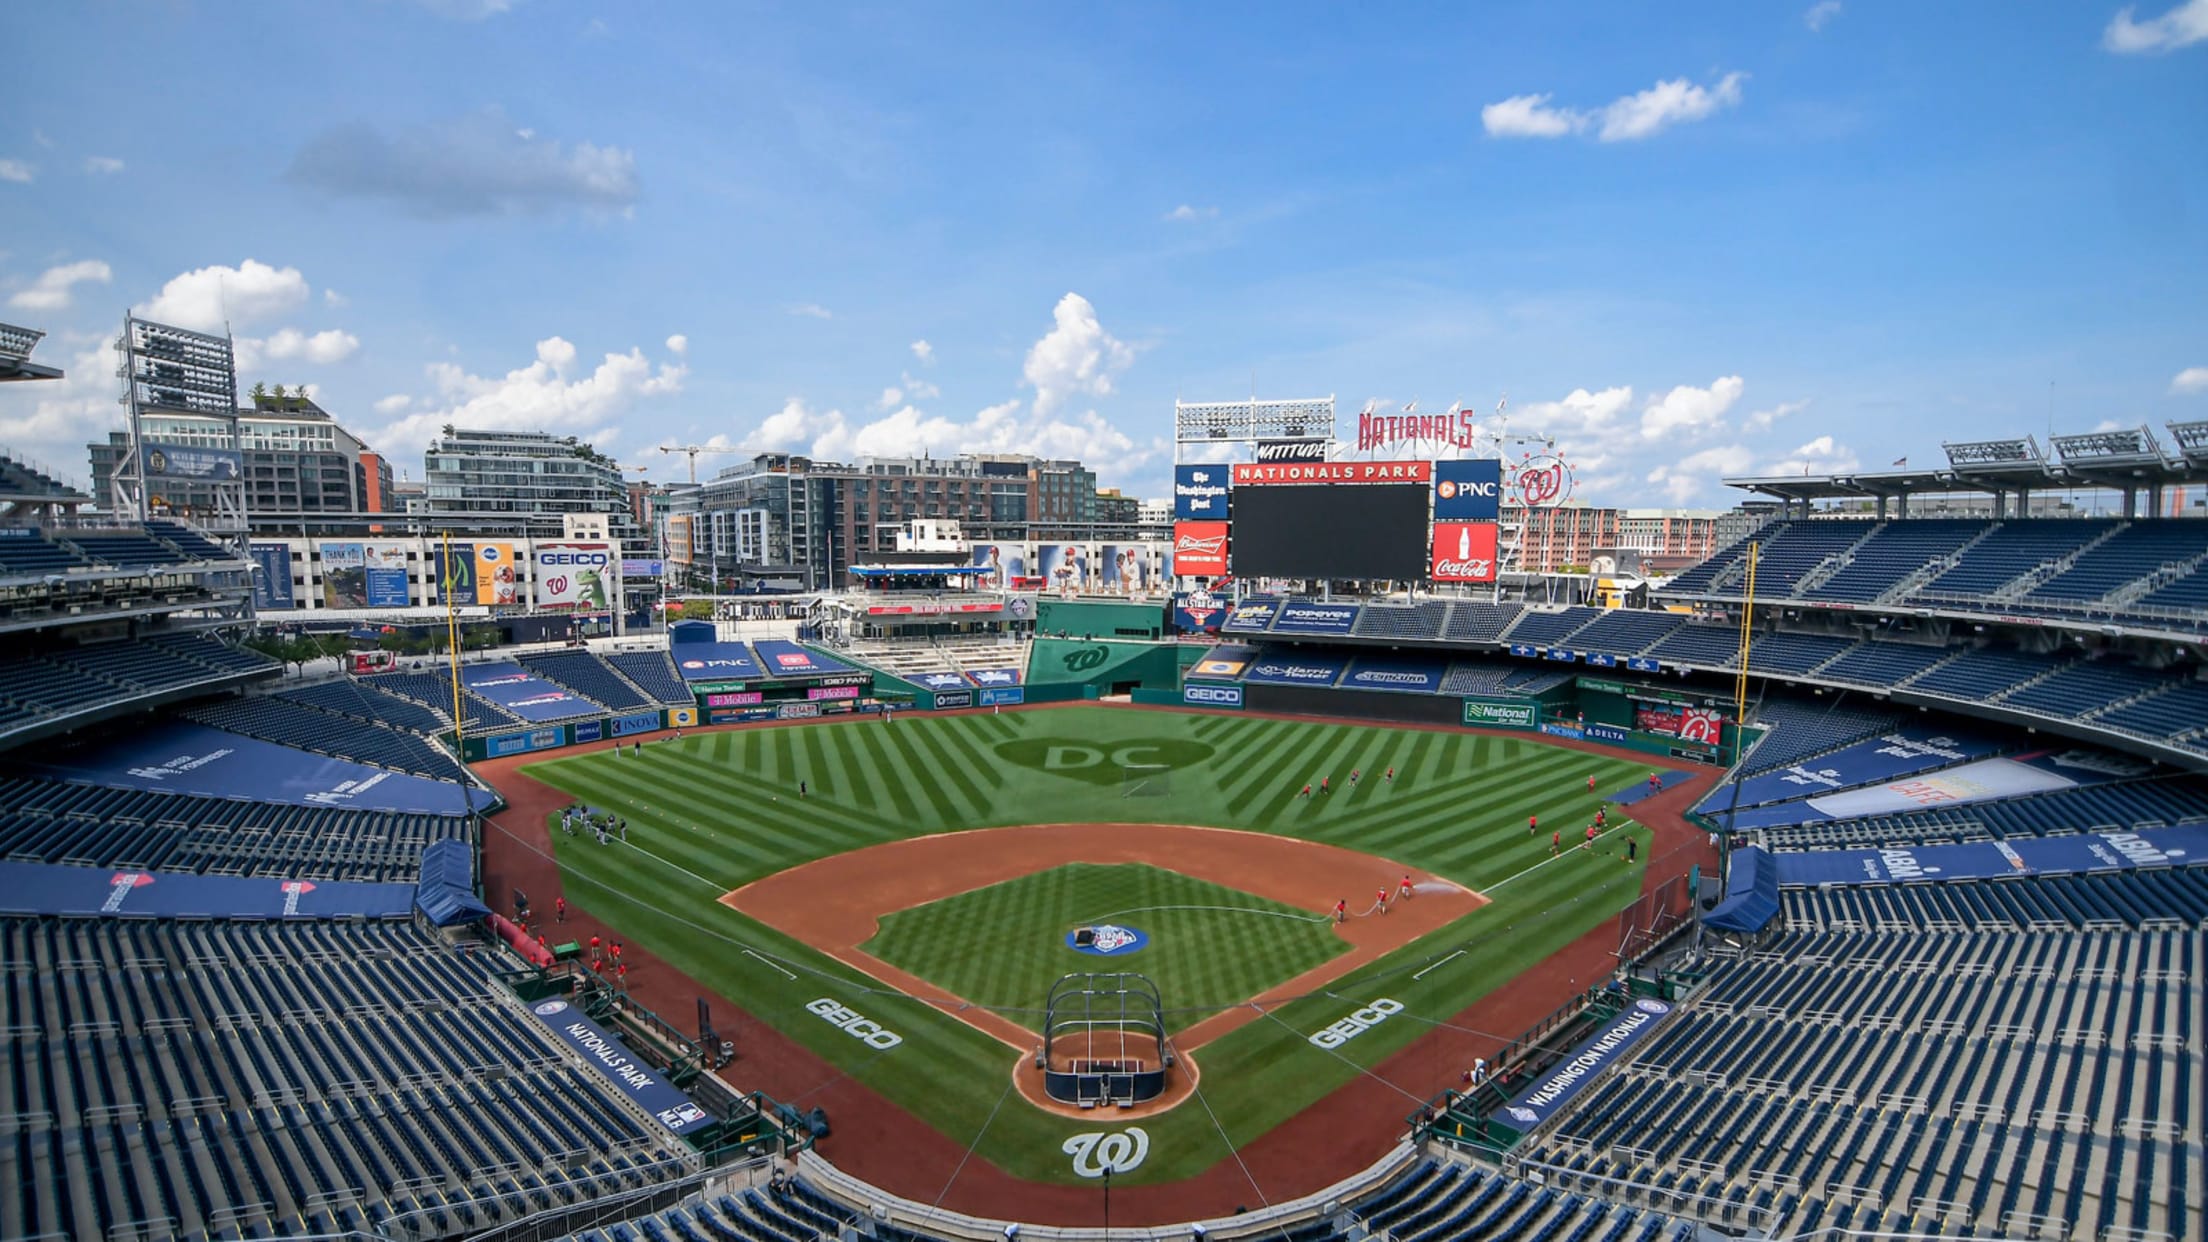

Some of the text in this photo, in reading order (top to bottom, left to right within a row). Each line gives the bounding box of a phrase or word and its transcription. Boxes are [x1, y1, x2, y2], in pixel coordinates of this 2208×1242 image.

[1358, 409, 1473, 451] NATIONALS
[1258, 443, 1325, 460] NATITUDE
[1192, 471, 1209, 483] The
[1239, 464, 1420, 480] NATIONALS PARK
[1176, 483, 1226, 497] Washington
[1458, 482, 1496, 497] PNC
[1190, 498, 1211, 511] Post
[540, 553, 606, 565] GEICO
[707, 659, 750, 667] PNC
[1284, 666, 1332, 674] Harris
[1284, 672, 1330, 680] Teeter
[1186, 689, 1239, 701] GEICO
[1483, 706, 1530, 718] National
[624, 716, 659, 730] INOVA
[1594, 729, 1625, 741] DELTA
[1044, 746, 1167, 769] DC
[2099, 833, 2169, 865] ABM
[1878, 849, 1924, 880] ABM
[805, 997, 904, 1050] GEICO
[1308, 997, 1405, 1050] GEICO
[565, 1022, 655, 1091] NATIONALS PARK
[1525, 1010, 1650, 1108] WASHINGTON NATIONALS
[656, 1108, 687, 1130] MLB
[1061, 1126, 1150, 1178] W
